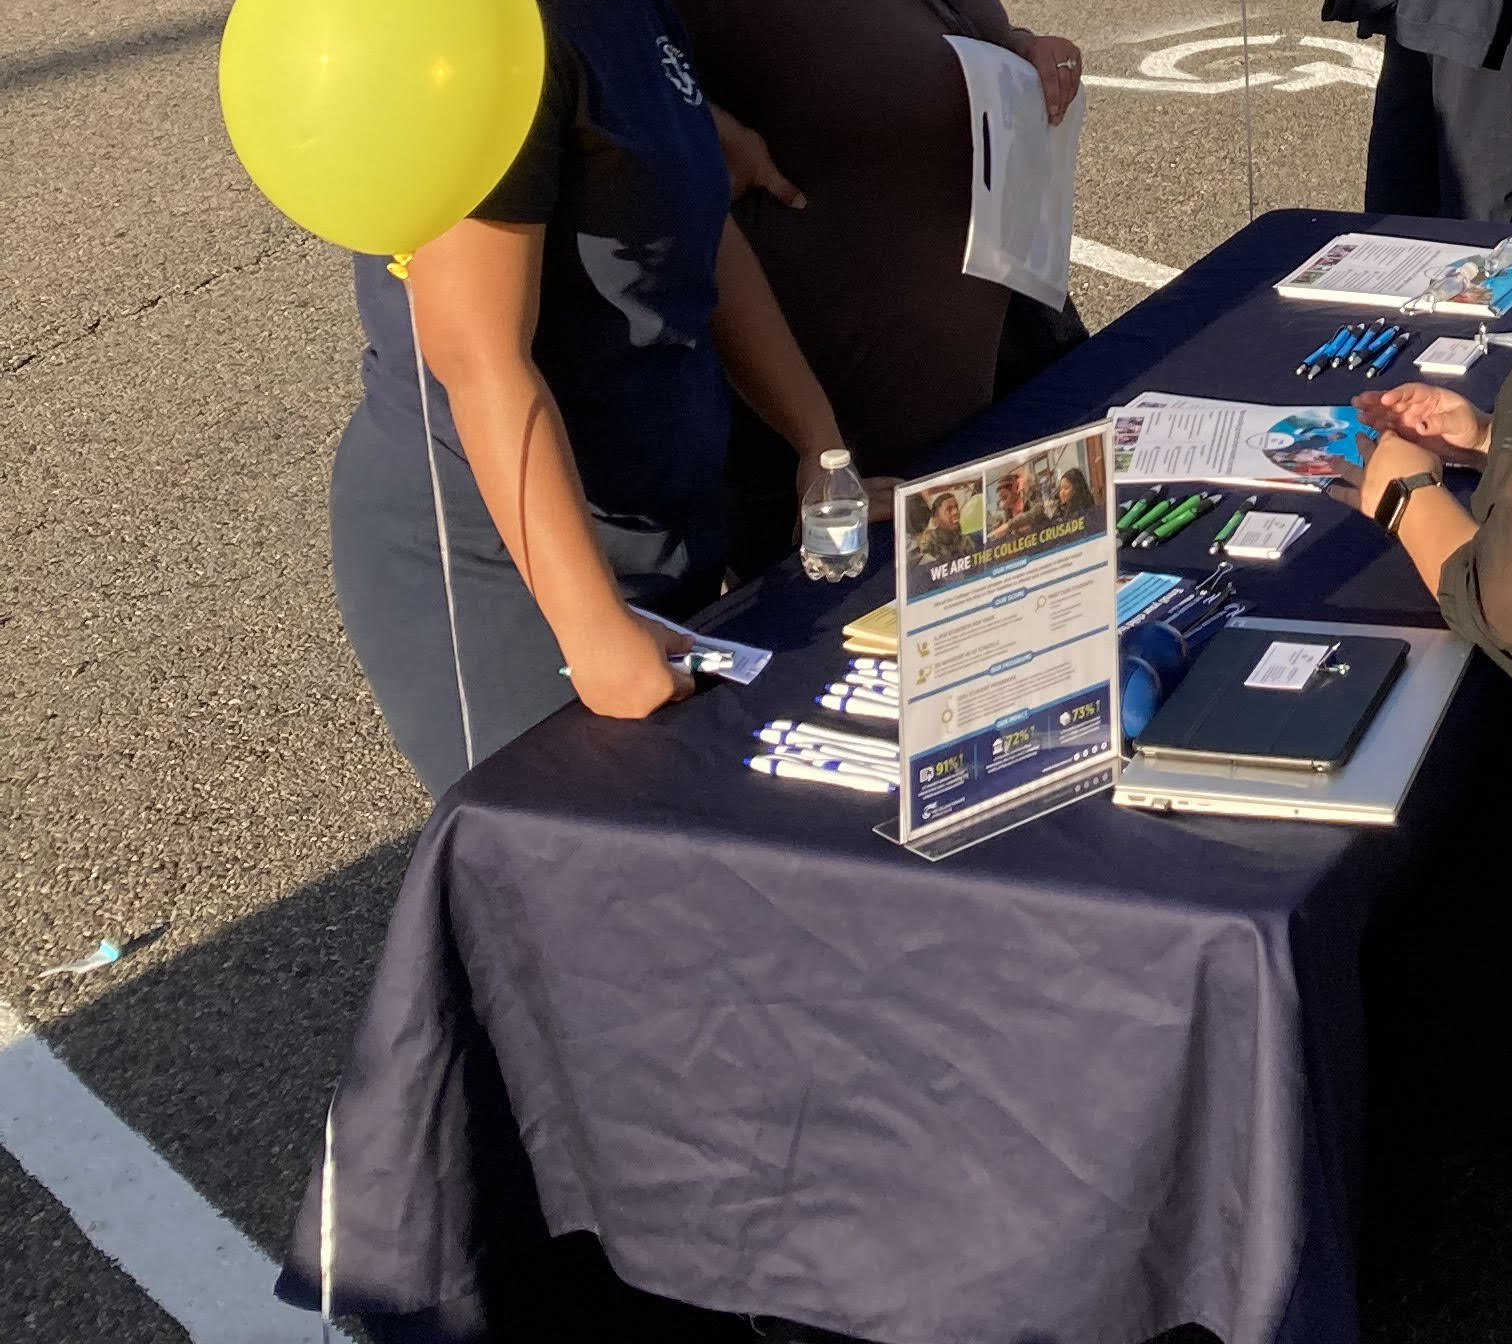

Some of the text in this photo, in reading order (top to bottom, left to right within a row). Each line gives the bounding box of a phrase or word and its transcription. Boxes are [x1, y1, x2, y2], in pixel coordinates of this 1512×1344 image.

[930, 516, 1086, 582] WE ARE THE COLLEGE CRUSADE
